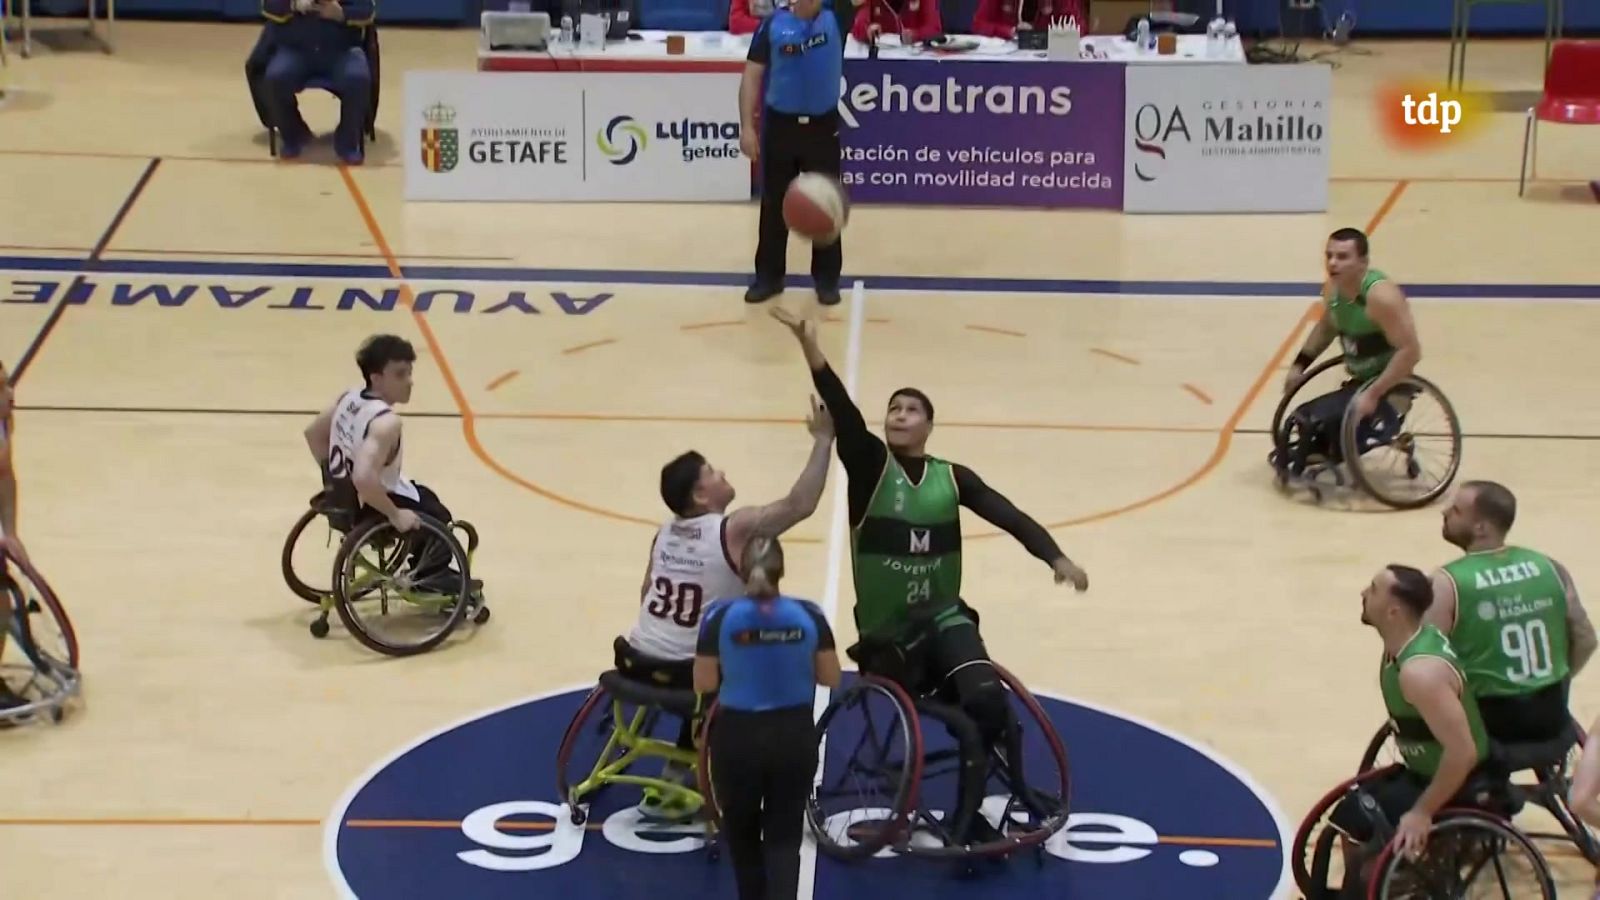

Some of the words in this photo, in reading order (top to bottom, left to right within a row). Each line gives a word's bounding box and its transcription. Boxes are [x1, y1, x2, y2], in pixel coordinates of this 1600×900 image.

[656, 117, 740, 147] Lyma
[1204, 116, 1323, 142] Mahillo
[469, 141, 568, 164] GETAFE
[682, 143, 740, 162] getafe
[915, 146, 941, 162] de
[946, 146, 1044, 164] vehículos
[1050, 151, 1096, 168] para
[870, 172, 908, 185] con
[914, 170, 1015, 187] movilidad
[1021, 172, 1113, 189] reducida
[910, 529, 931, 553] M
[1475, 561, 1541, 590] ALEXIS
[648, 576, 703, 628] 30
[906, 579, 931, 604] 24
[1501, 619, 1553, 685] 90
